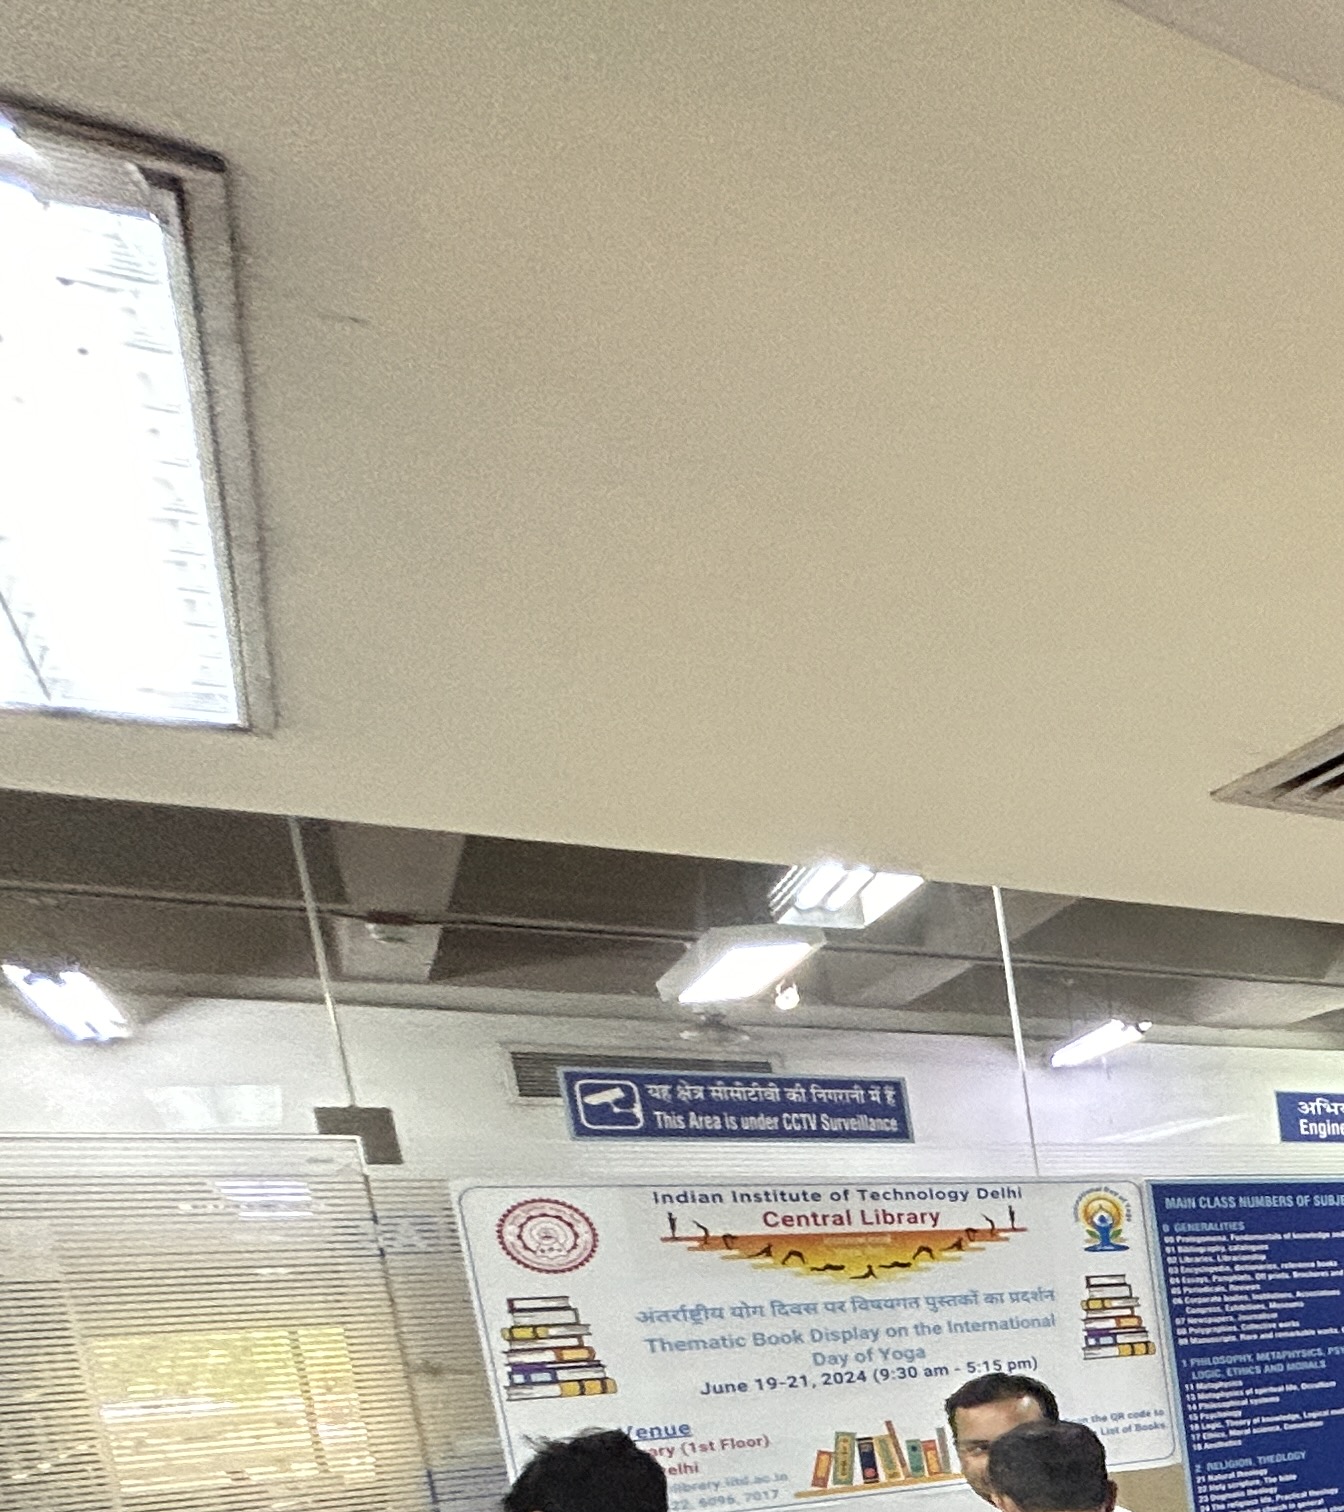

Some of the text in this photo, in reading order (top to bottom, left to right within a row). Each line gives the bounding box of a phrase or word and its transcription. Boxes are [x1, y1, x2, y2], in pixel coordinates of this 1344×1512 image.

[646, 1083, 672, 1102] यह
[785, 1081, 808, 1103] की
[655, 1110, 898, 1133] This Area is under CCTV Surveillance
[653, 1186, 1023, 1205] Indian Institute of Technology Delhi
[1164, 1196, 1196, 1209] MAIN
[1198, 1195, 1236, 1208] CLASS
[1238, 1195, 1294, 1208] NUMBERS
[1295, 1195, 1311, 1207] OF
[763, 1208, 941, 1229] Central Library
[730, 1302, 765, 1320] योग
[770, 1299, 819, 1318] दिवस
[824, 1298, 848, 1315] पर
[851, 1295, 920, 1314] विषयगत
[925, 1289, 980, 1314] पुस्तकों
[983, 1291, 1005, 1306] का
[1008, 1287, 1057, 1306] प्रदर्शन
[644, 1313, 1057, 1354] Thematic Book Display on the International
[812, 1345, 926, 1370] Day of Yoga
[1226, 1364, 1261, 1376] ETHICS
[1263, 1362, 1284, 1373] AND
[1286, 1359, 1326, 1371] MORALS
[699, 1380, 749, 1397] June
[754, 1373, 818, 1393] 19-21,
[822, 1369, 868, 1387] 2024
[873, 1365, 918, 1385] (9:30
[923, 1364, 950, 1378] am
[966, 1357, 1003, 1375] 5:15
[1006, 1355, 1039, 1375] pm)
[1090, 1414, 1108, 1423] the
[1110, 1412, 1125, 1422] QR
[1127, 1410, 1151, 1419] code
[1153, 1408, 1165, 1416] to
[1100, 1421, 1166, 1436] List of Books
[680, 1441, 715, 1458] (1st
[720, 1435, 770, 1451] Floor)
[1257, 1450, 1306, 1465] THEOLOGY
[664, 1462, 700, 1475] elhi
